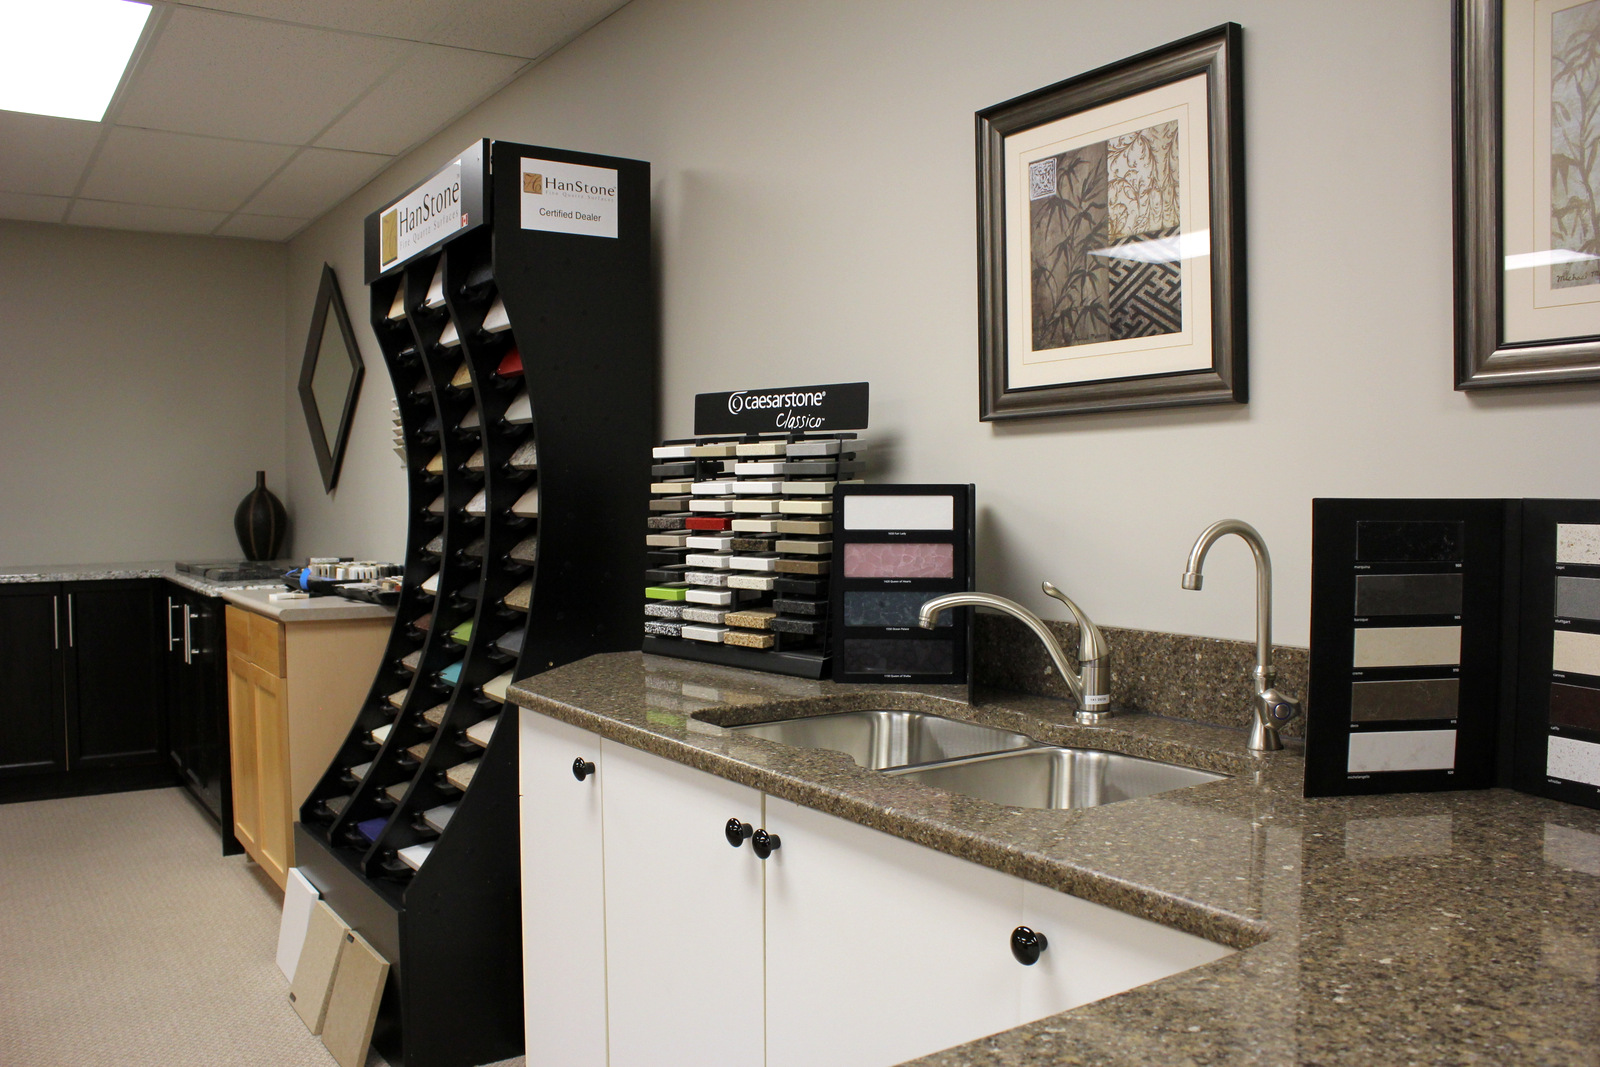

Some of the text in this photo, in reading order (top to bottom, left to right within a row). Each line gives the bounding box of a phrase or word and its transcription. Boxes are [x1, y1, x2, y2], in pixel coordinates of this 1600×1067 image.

[545, 177, 615, 196] HanStone
[562, 191, 584, 199] Quartz
[399, 182, 459, 237] HanStone
[539, 207, 602, 222] Certified Dealer
[400, 210, 459, 251] Fine Quartz Surfaces
[744, 391, 823, 410] caesarstone
[775, 409, 822, 430] Classico
